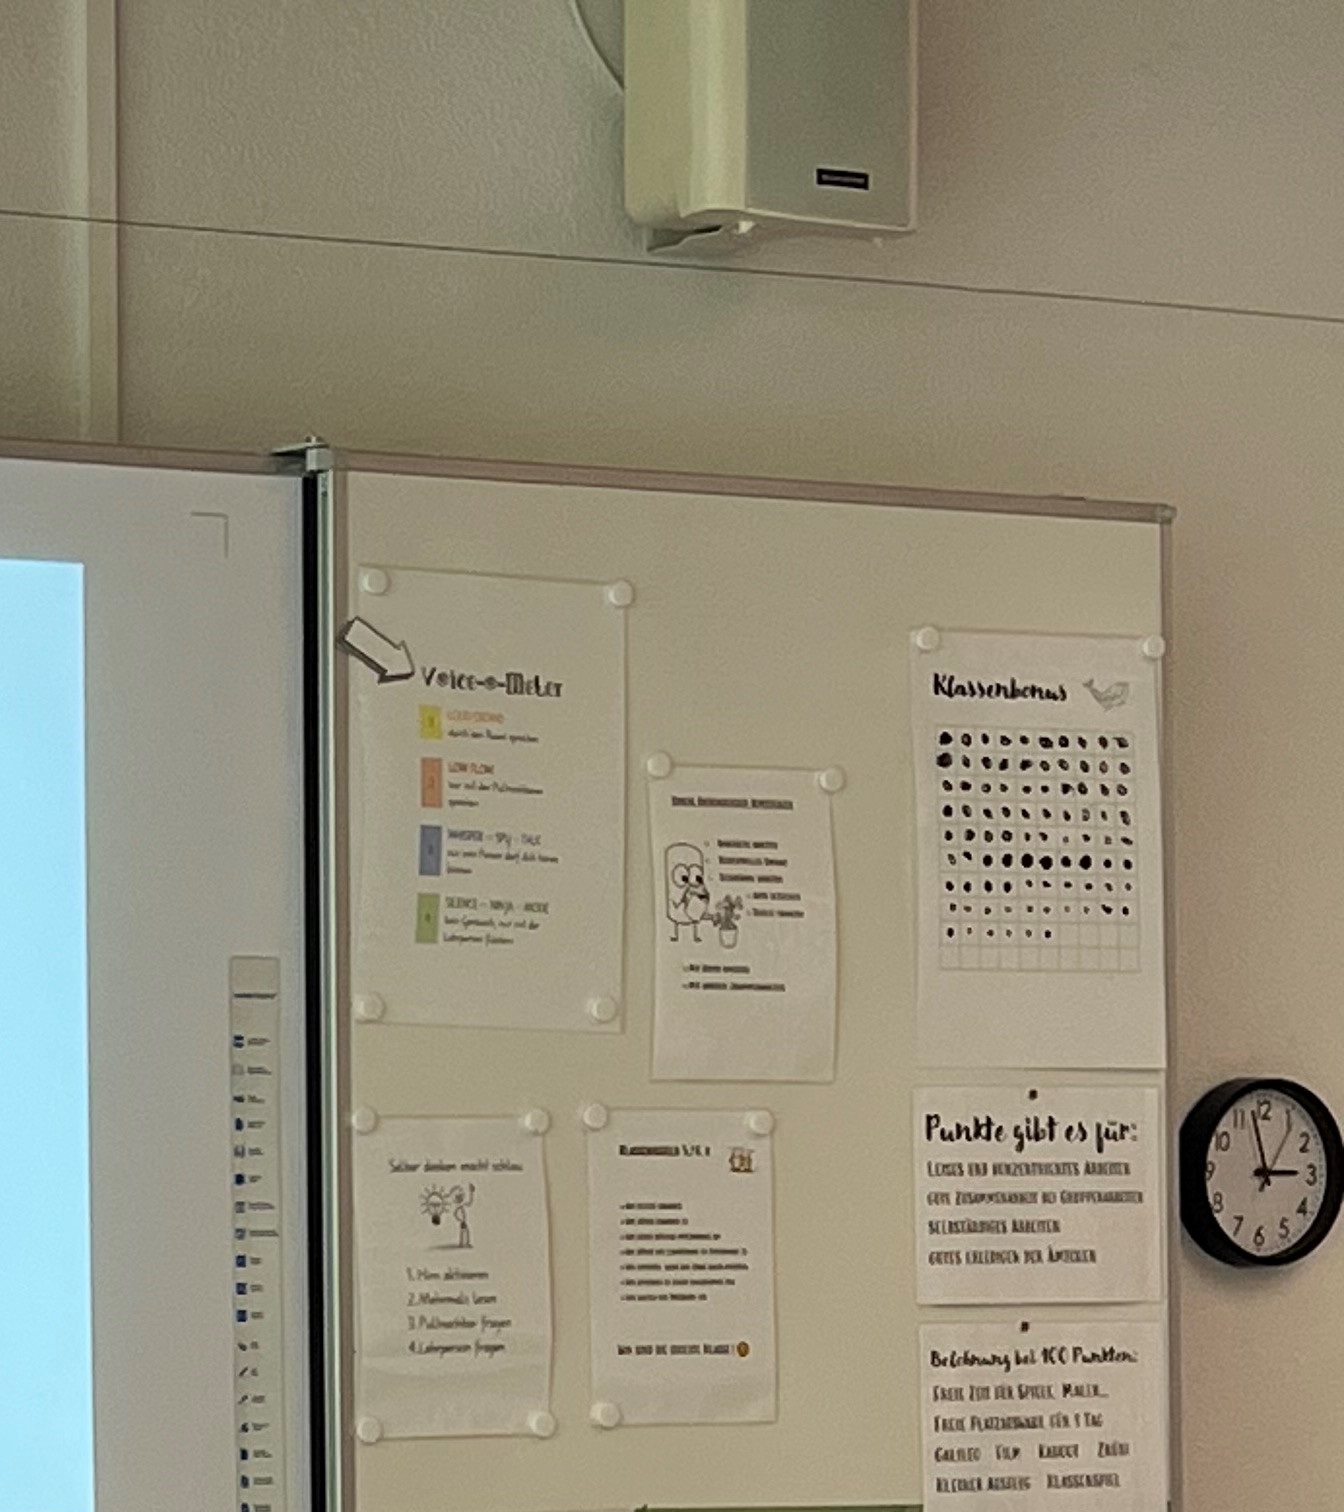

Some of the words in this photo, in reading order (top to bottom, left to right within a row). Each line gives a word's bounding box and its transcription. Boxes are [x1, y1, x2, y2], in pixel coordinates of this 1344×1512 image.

[933, 672, 1069, 702] Klassenbonus
[1232, 1108, 1246, 1130] 11
[1256, 1099, 1272, 1122] 12
[924, 1112, 1008, 1143] Punkte
[1012, 1114, 1060, 1154] gibt
[1064, 1120, 1089, 1142] es
[1094, 1119, 1139, 1154] für:
[1214, 1130, 1231, 1152] 10
[1298, 1131, 1311, 1154] 2
[1204, 1160, 1216, 1182] 9
[1304, 1163, 1318, 1187] 3
[1212, 1190, 1224, 1214] 8
[1295, 1196, 1309, 1217] 4
[1232, 1214, 1245, 1237] 7
[1252, 1225, 1266, 1247] 6
[1278, 1216, 1291, 1239] 5
